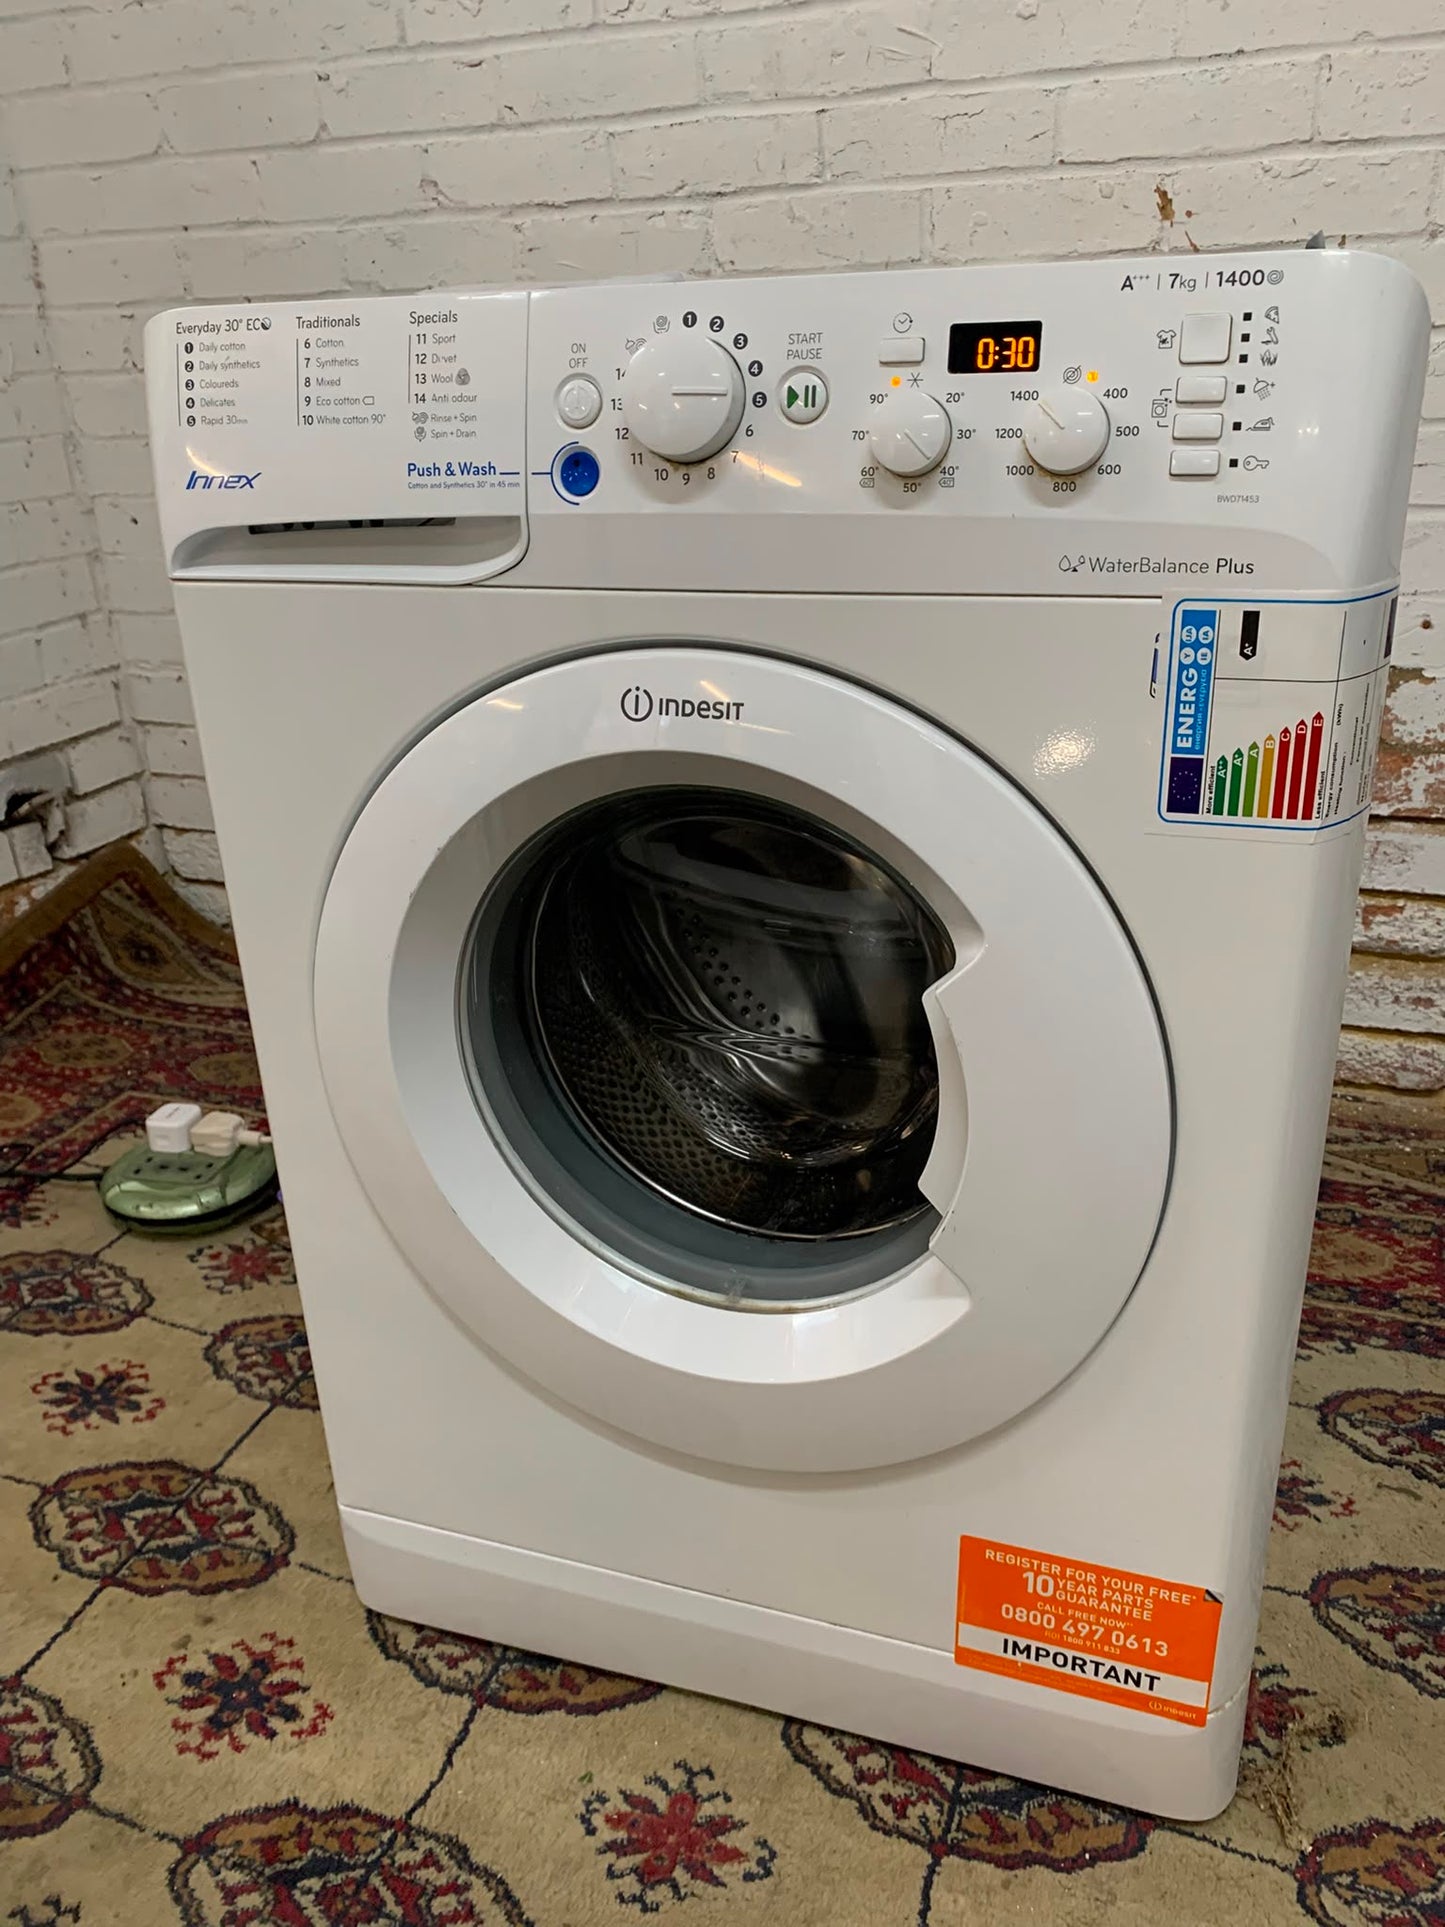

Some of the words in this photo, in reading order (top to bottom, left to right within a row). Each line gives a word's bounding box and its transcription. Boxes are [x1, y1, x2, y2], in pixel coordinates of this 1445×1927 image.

[1168, 273, 1197, 292] 7kg
[1216, 269, 1265, 287] 1400
[296, 314, 361, 329] Traditionals
[409, 310, 458, 327] Specials
[682, 311, 697, 328] 1
[709, 316, 724, 333] 2
[176, 321, 221, 335] Everyday
[225, 319, 243, 331] 30°
[304, 339, 311, 349] 6
[315, 338, 344, 349] Cotton
[416, 333, 427, 344] 11
[432, 333, 456, 345] Sport
[733, 333, 748, 349] 3
[788, 333, 823, 345] START
[185, 342, 194, 354] 1
[199, 342, 218, 353] Daily
[220, 343, 246, 351] cotton
[571, 343, 587, 353] ON
[786, 348, 823, 360] PAUSE
[976, 337, 1035, 369] 0:30
[304, 358, 311, 368] 7
[315, 357, 359, 369] Synthetics
[415, 353, 427, 364] 12
[569, 358, 588, 368] OFF
[185, 360, 194, 373] 2
[199, 360, 218, 371] Daily
[220, 360, 260, 370] synthetics
[748, 360, 763, 377] 4
[304, 377, 311, 388] 8
[316, 377, 341, 387] Mixed
[415, 373, 427, 384] 13
[431, 373, 453, 383] Wool
[185, 379, 194, 391] 3
[199, 379, 239, 389] Coloureds
[414, 393, 427, 404] 14
[431, 393, 449, 402] Anti
[451, 392, 477, 403] odour
[752, 391, 767, 408] 5
[870, 393, 888, 404] 90°
[946, 392, 965, 403] 20°
[1010, 390, 1039, 401] 1400
[1103, 388, 1128, 399] 400
[186, 397, 195, 409] 4
[200, 398, 235, 407] Delicates
[304, 396, 311, 407] 9
[316, 396, 331, 406] Eco
[333, 396, 361, 406] cotton
[187, 415, 196, 427] 5
[201, 416, 224, 426] Rapid
[302, 415, 314, 425] 10
[316, 415, 341, 425] White
[342, 415, 369, 425] cotton
[370, 413, 386, 424] 90°
[431, 413, 452, 422] Rinse
[459, 413, 477, 423] Spin
[431, 429, 448, 439] Spin
[456, 429, 476, 438] Drain
[615, 428, 629, 439] 12
[745, 425, 754, 437] 6
[852, 430, 870, 440] 70°
[957, 429, 977, 439] 30°
[995, 428, 1023, 439] 1200
[1115, 426, 1140, 437] 500
[630, 453, 643, 464] 11
[732, 451, 740, 463] 7
[407, 462, 441, 477] Push
[445, 461, 456, 476] &
[458, 461, 496, 476] Wash
[654, 468, 669, 481] 10
[707, 468, 716, 480] 8
[861, 466, 879, 477] 60°
[940, 466, 959, 476] 40°
[1006, 465, 1034, 476] 1000
[1097, 464, 1121, 475] 600
[185, 471, 262, 490] Innex
[408, 481, 428, 489] Cotton
[430, 481, 442, 489] and
[443, 481, 475, 490] Synthetics
[497, 480, 506, 488] 45
[507, 480, 520, 488] min
[682, 473, 690, 485] 9
[903, 482, 922, 493] 50°
[1052, 482, 1077, 493] 800
[1089, 556, 1209, 575] WaterBalance
[1216, 556, 1254, 575] Plus
[1177, 668, 1198, 748] ENERG
[1314, 718, 1323, 727] E
[1297, 725, 1306, 734] D
[1281, 732, 1290, 741] C
[1266, 739, 1274, 748] B
[1250, 748, 1258, 757] A
[1208, 766, 1216, 793] efficient
[985, 1549, 1061, 1575] REGISTER
[1066, 1567, 1096, 1584] FOR
[1102, 1576, 1144, 1595] YOUR
[1023, 1571, 1054, 1597] 10
[1057, 1578, 1097, 1596] YEAR
[1102, 1589, 1153, 1609] PARTS
[1056, 1590, 1152, 1621] GUARANTEE
[1037, 1602, 1064, 1615] CALL
[1068, 1609, 1096, 1622] FREE
[1001, 1603, 1055, 1629] 0800
[1063, 1620, 1104, 1640] 497
[1111, 1630, 1168, 1656] 0613
[1003, 1638, 1160, 1691] IMPORTANT
